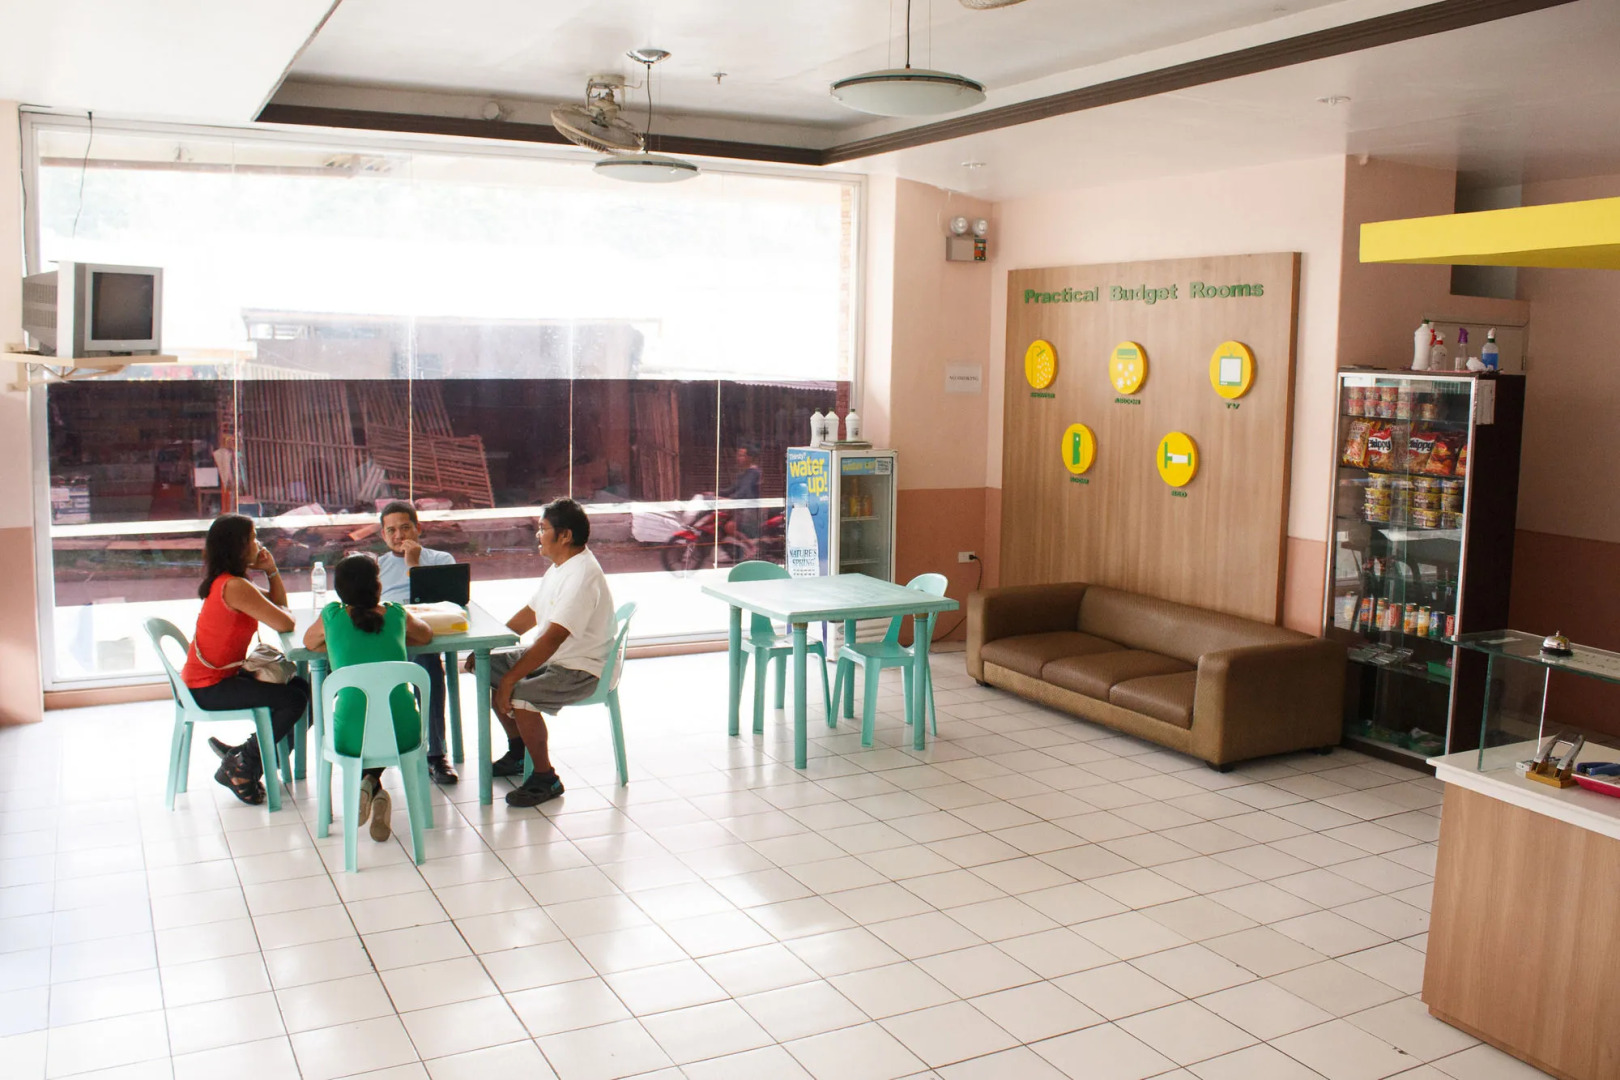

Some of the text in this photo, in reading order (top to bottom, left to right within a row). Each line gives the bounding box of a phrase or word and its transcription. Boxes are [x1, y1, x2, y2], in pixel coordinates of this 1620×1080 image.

[1024, 281, 1265, 305] Practical Budget Rooms
[1225, 402, 1241, 410] TV
[789, 456, 825, 478] water
[808, 471, 828, 497] up!
[789, 549, 817, 558] NATURE'S
